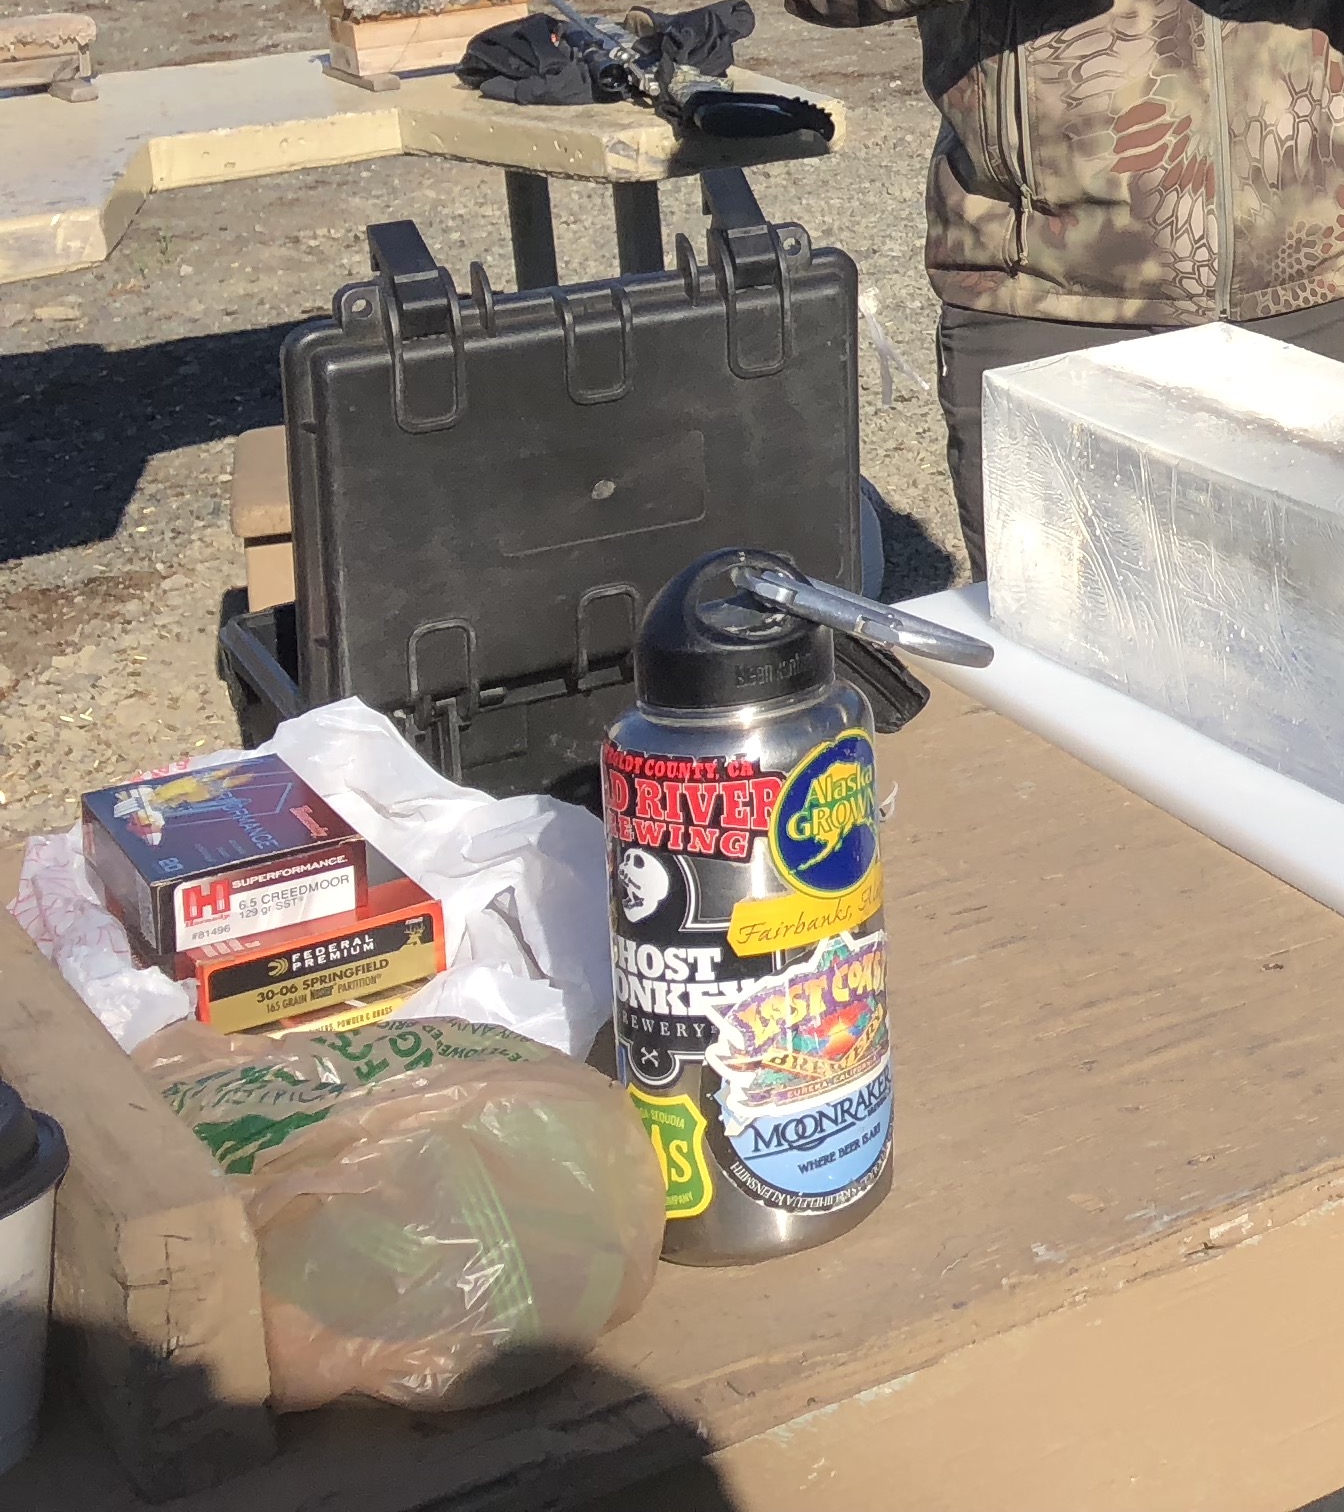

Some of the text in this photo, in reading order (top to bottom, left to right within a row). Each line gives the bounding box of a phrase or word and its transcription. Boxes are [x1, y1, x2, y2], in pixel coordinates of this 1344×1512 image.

[727, 758, 754, 777] CA
[635, 776, 785, 830] RIVER
[805, 765, 872, 808] Alaska
[607, 810, 749, 857] REWING
[238, 874, 350, 911] 6.5 CREEDMOOR
[239, 908, 258, 919] 129
[261, 905, 272, 916] gr
[736, 898, 853, 945] Fairbanks,
[292, 934, 374, 962] FEDERAL
[292, 941, 375, 972] PREMIUM
[614, 935, 722, 981] HOST
[256, 958, 390, 1004] 30-06 SPRINGFIELD
[266, 1002, 281, 1014] 165
[282, 993, 308, 1010] GRAIN
[337, 1014, 364, 1029] POWDER
[619, 1010, 706, 1038] REWERY
[651, 1109, 685, 1130] SEQUOIA
[752, 1062, 892, 1152] MOONRAKER
[797, 1150, 836, 1175] WHERE
[838, 1140, 861, 1158] BEER
[665, 1191, 693, 1206] OMPANY
[729, 1161, 784, 1207] KLEINSMITH
